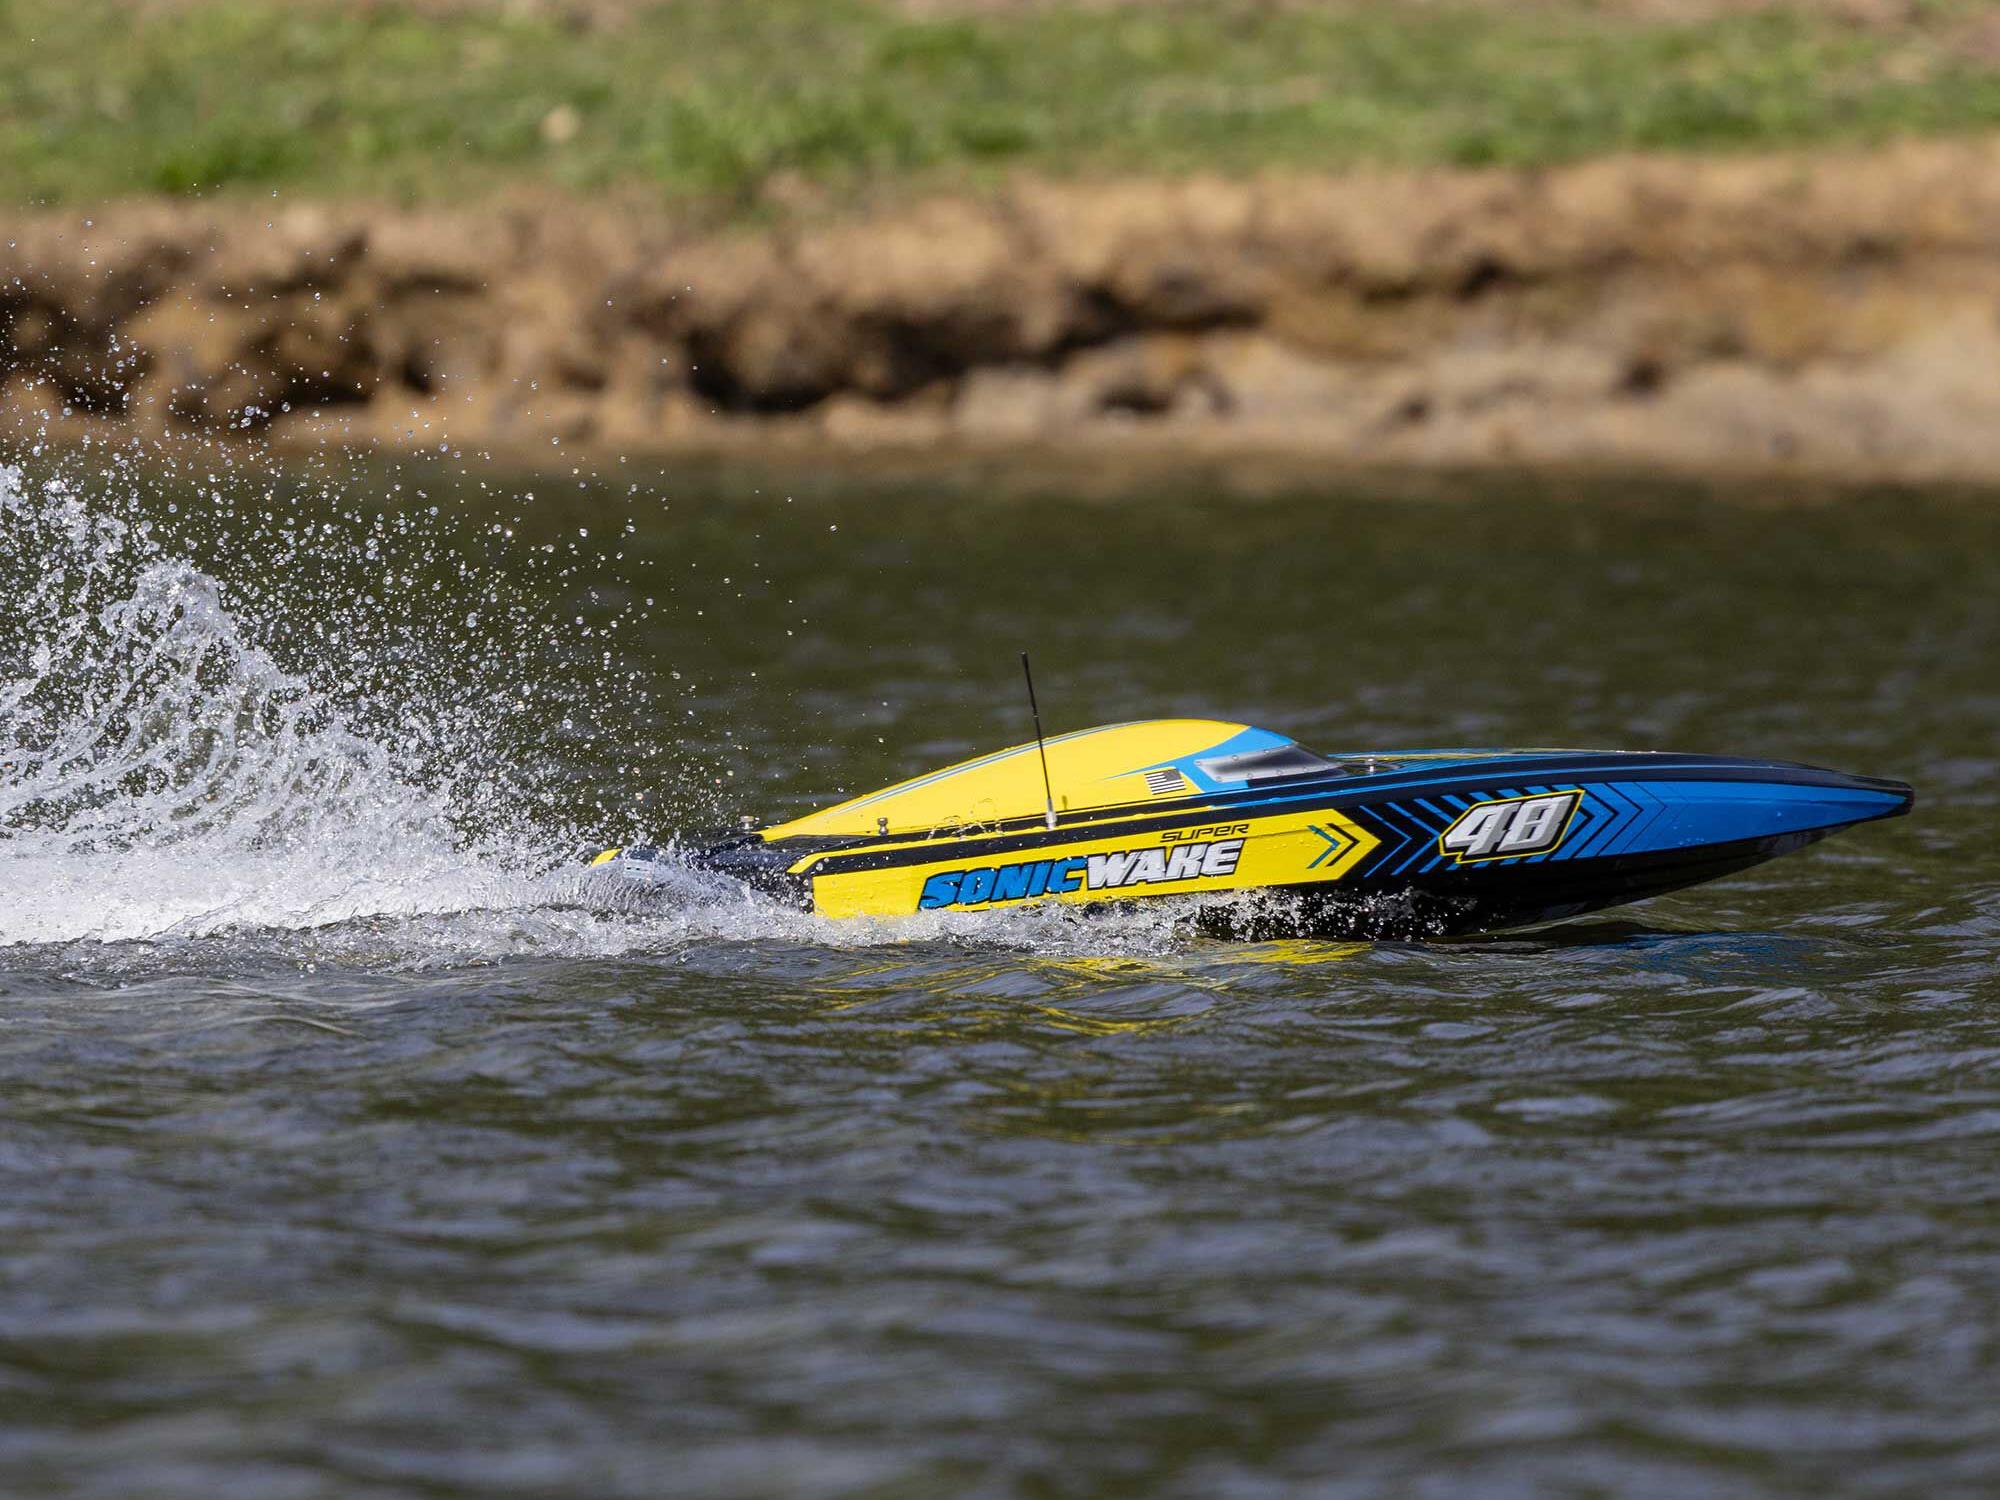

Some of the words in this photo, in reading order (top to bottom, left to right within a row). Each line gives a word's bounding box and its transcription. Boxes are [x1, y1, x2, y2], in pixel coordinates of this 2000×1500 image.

[1160, 824, 1249, 842] SUPER
[1445, 795, 1574, 856] 48
[918, 839, 1246, 911] SONICWAKE
